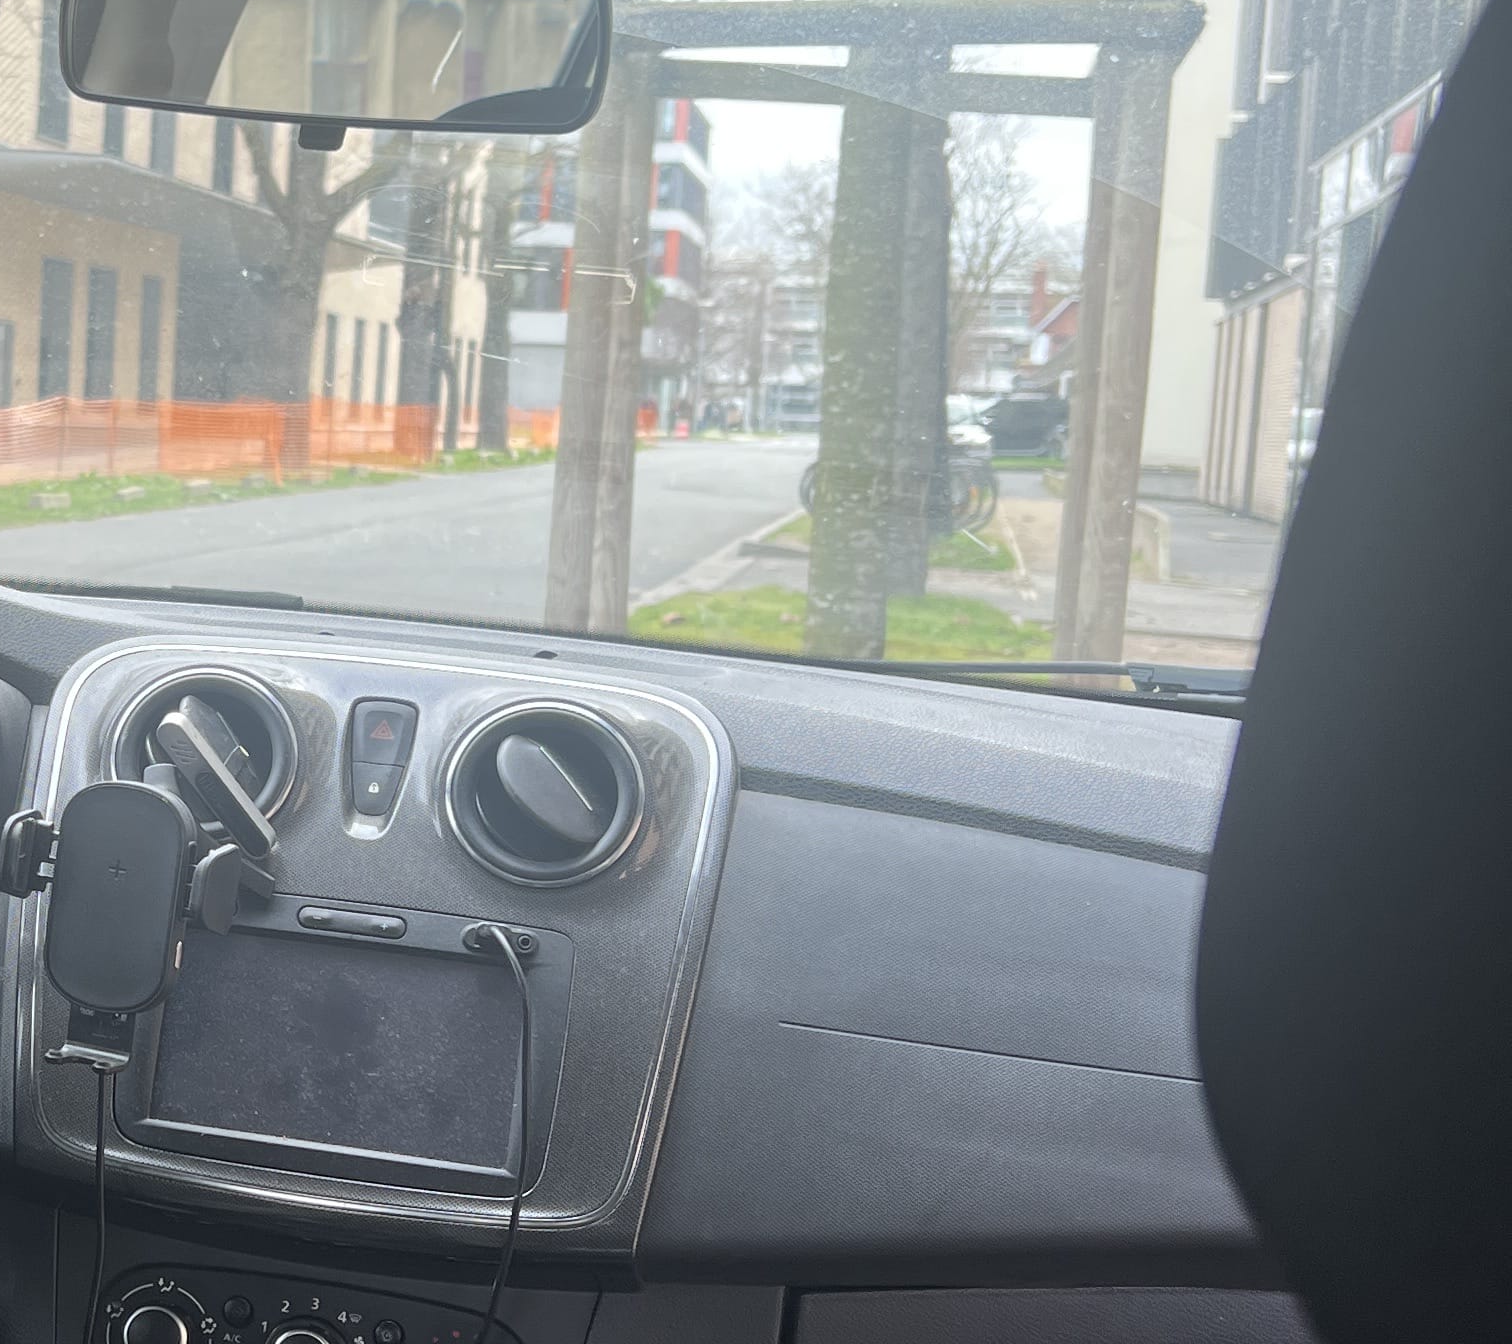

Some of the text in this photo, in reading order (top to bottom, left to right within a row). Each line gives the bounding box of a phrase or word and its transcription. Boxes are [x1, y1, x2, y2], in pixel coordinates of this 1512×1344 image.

[281, 1300, 290, 1313] 2
[311, 1297, 320, 1310] 3
[338, 1311, 347, 1323] 4
[261, 1321, 268, 1333] 1
[223, 1333, 241, 1344] A/C
